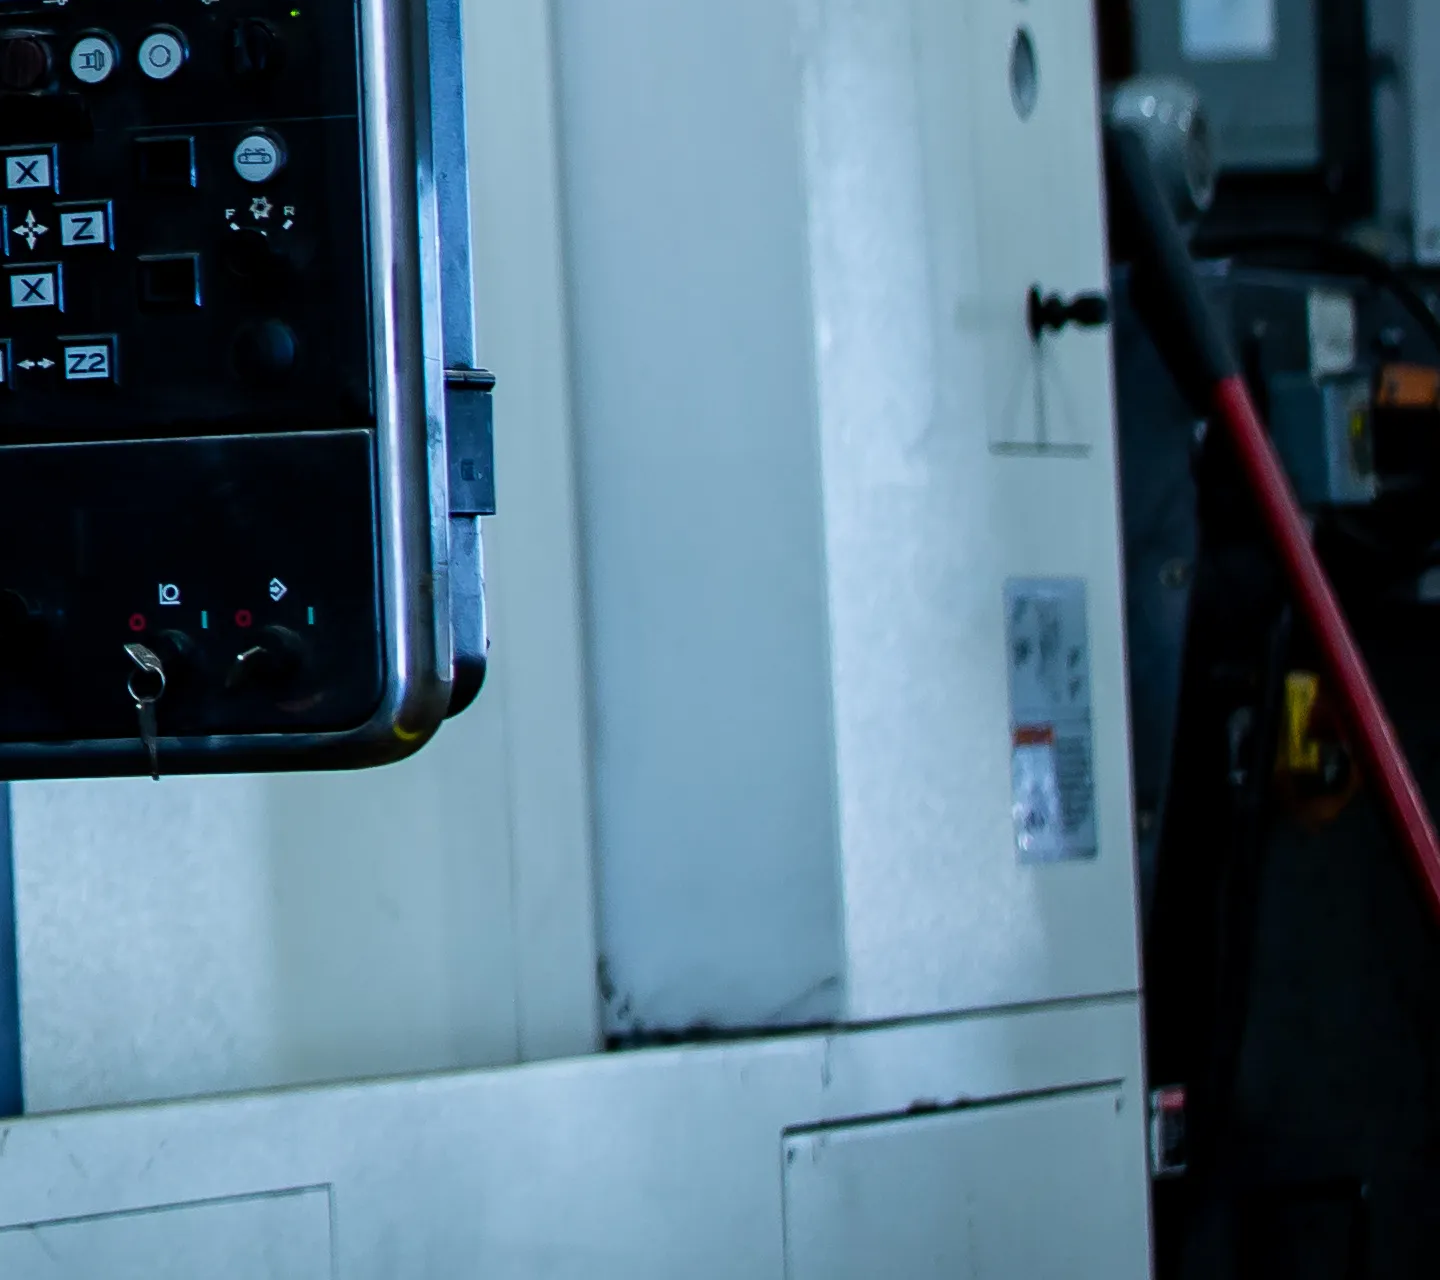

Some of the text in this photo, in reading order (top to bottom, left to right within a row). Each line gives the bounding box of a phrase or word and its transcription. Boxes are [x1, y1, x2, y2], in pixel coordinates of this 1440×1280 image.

[14, 159, 39, 184] X
[70, 216, 95, 241] Z
[20, 276, 46, 302] X
[66, 351, 106, 375] Z2
